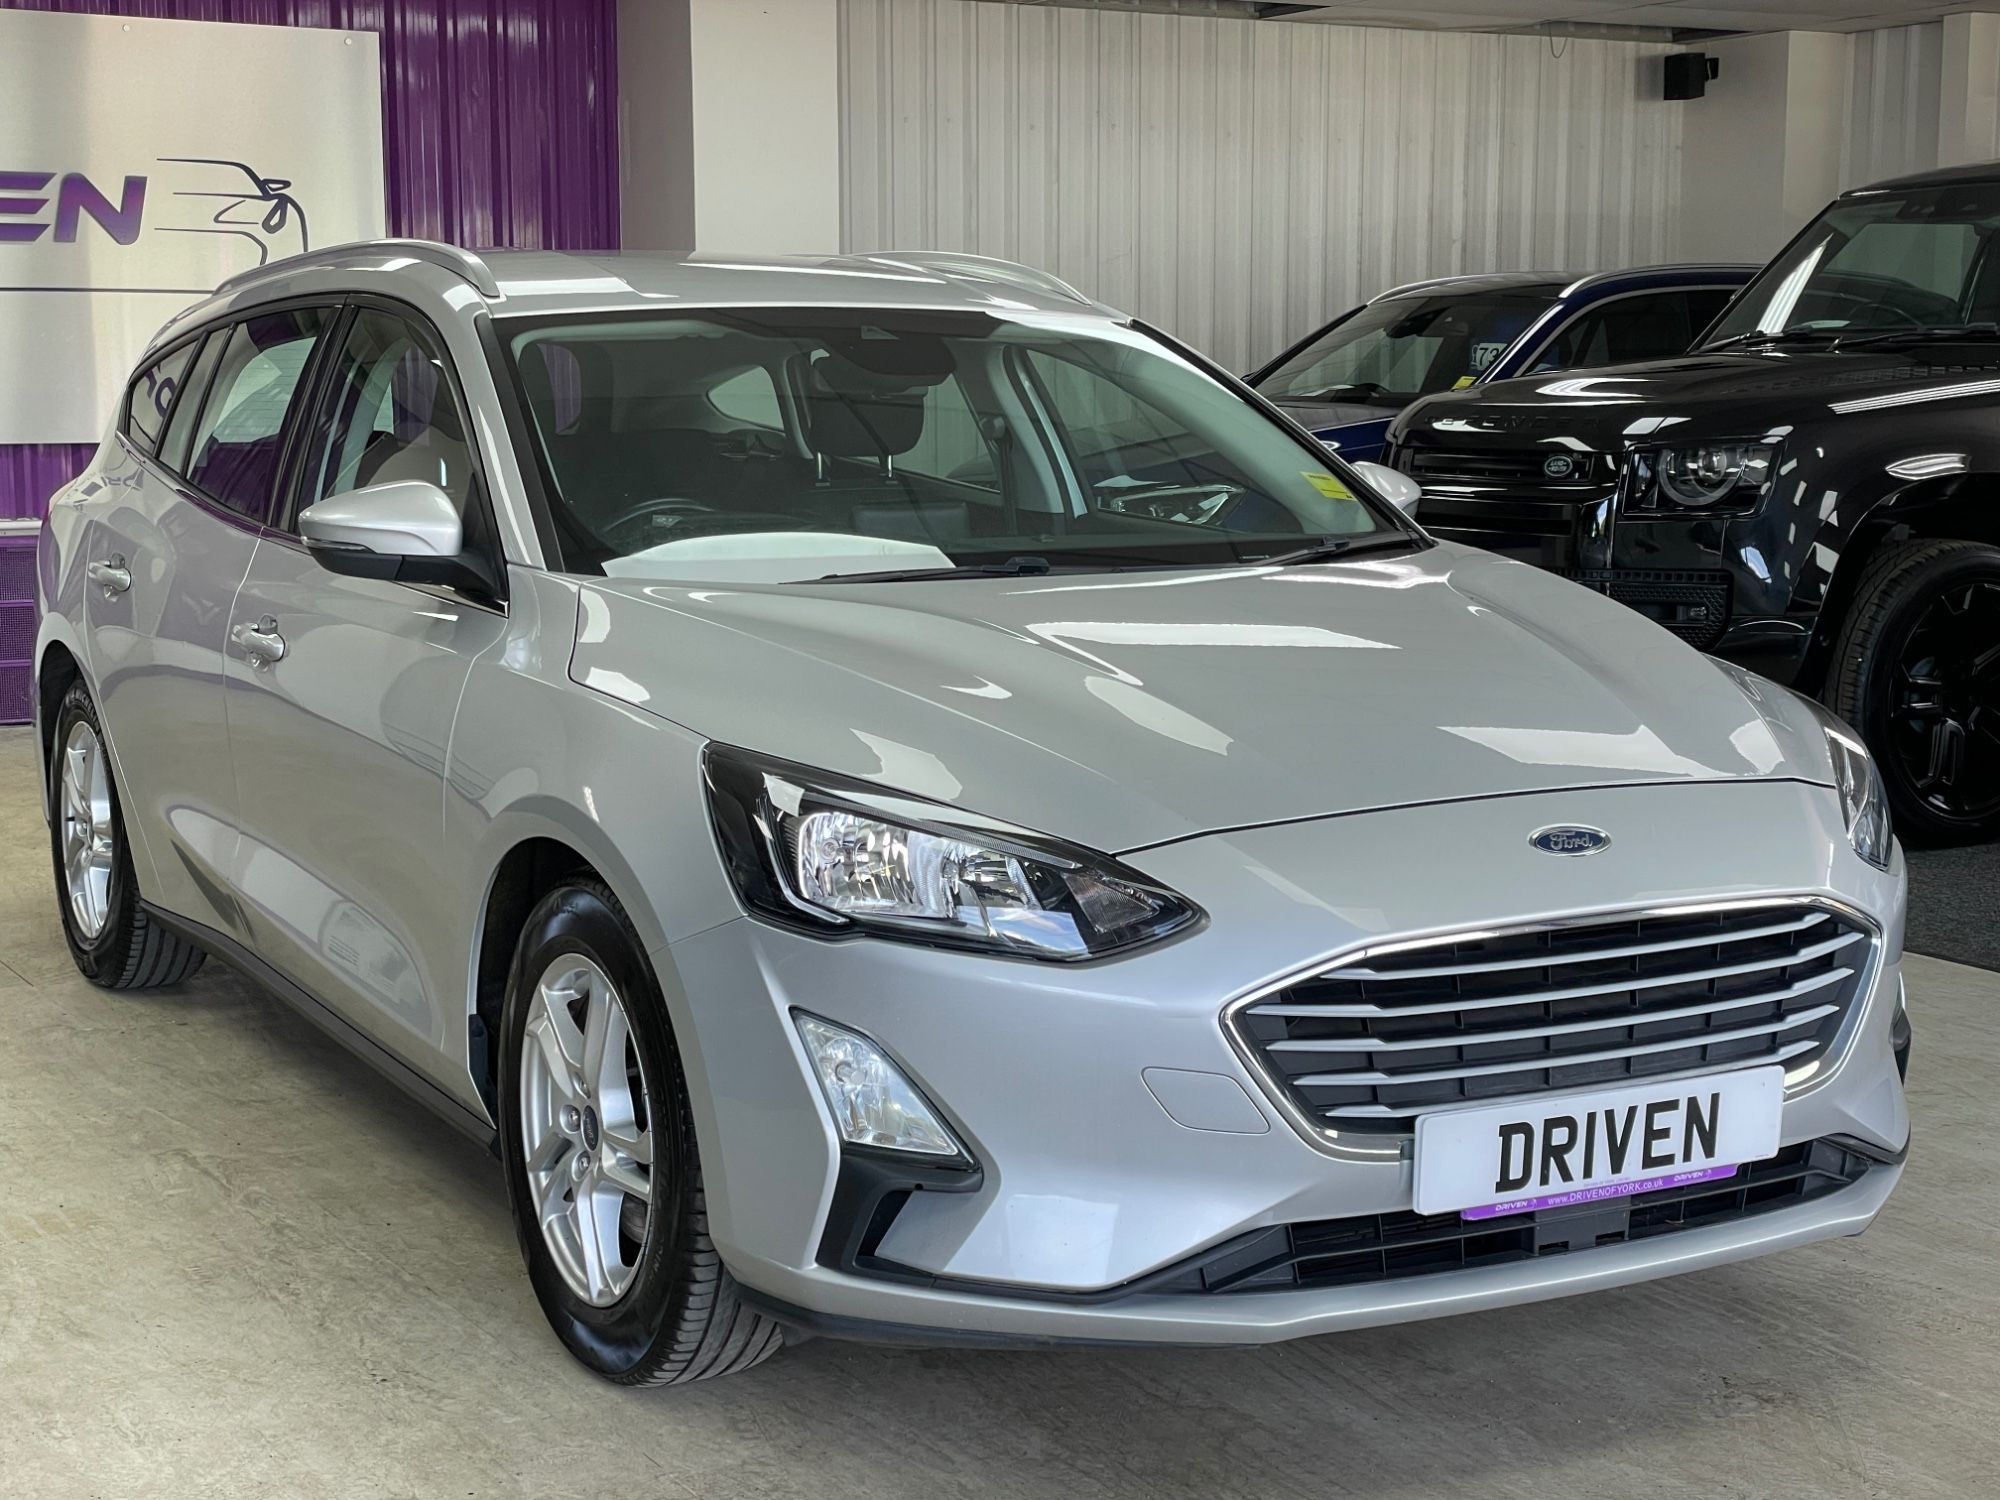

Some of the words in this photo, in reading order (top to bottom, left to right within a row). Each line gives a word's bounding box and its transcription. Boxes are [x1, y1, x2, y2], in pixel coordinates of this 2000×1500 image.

[1551, 831, 1593, 850] Ford
[1495, 1092, 1720, 1193] DRIVEN
[1495, 1199, 1528, 1212] DRIVEN
[1547, 1179, 1664, 1206] www.DRIVENOFYORK.co.uk
[1673, 1170, 1704, 1182] DRIVEN
